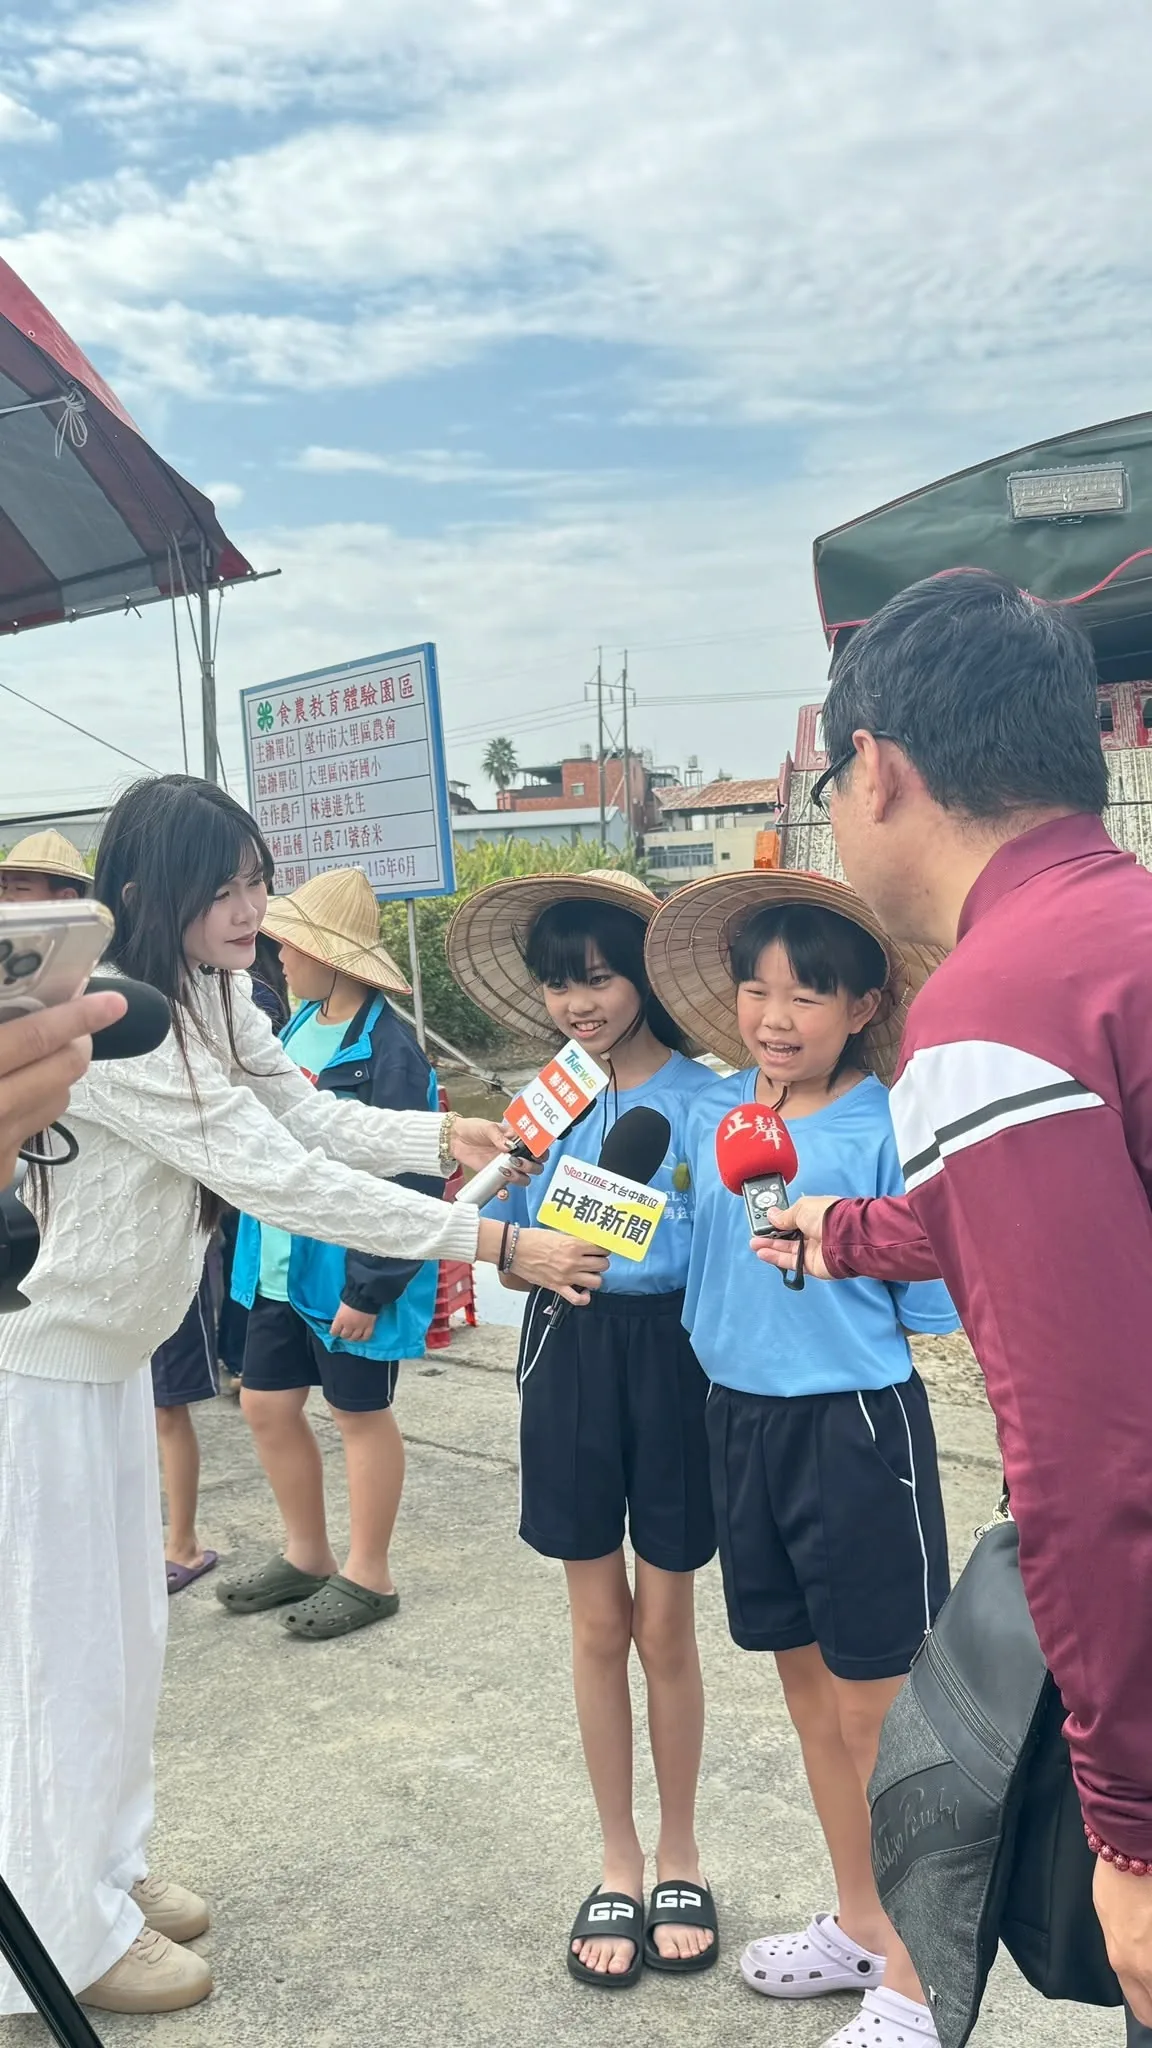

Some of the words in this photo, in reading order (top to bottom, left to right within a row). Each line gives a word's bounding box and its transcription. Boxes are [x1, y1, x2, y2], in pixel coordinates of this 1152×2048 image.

[276, 673, 415, 727] 食農教育體驗園區
[256, 736, 296, 764] 主辦單位
[304, 716, 396, 754] 臺中市大里區農會
[257, 769, 299, 795] 協辦單位
[259, 801, 300, 827] 合作農戶
[312, 823, 383, 853] 台農71號香米
[565, 1049, 597, 1090] TNEWS
[724, 1111, 785, 1150] 正聲
[607, 1182, 659, 1210] 大台中數位
[551, 1186, 653, 1246] 中都新聞
[587, 1901, 634, 1922] GP
[656, 1889, 702, 1909] GP
